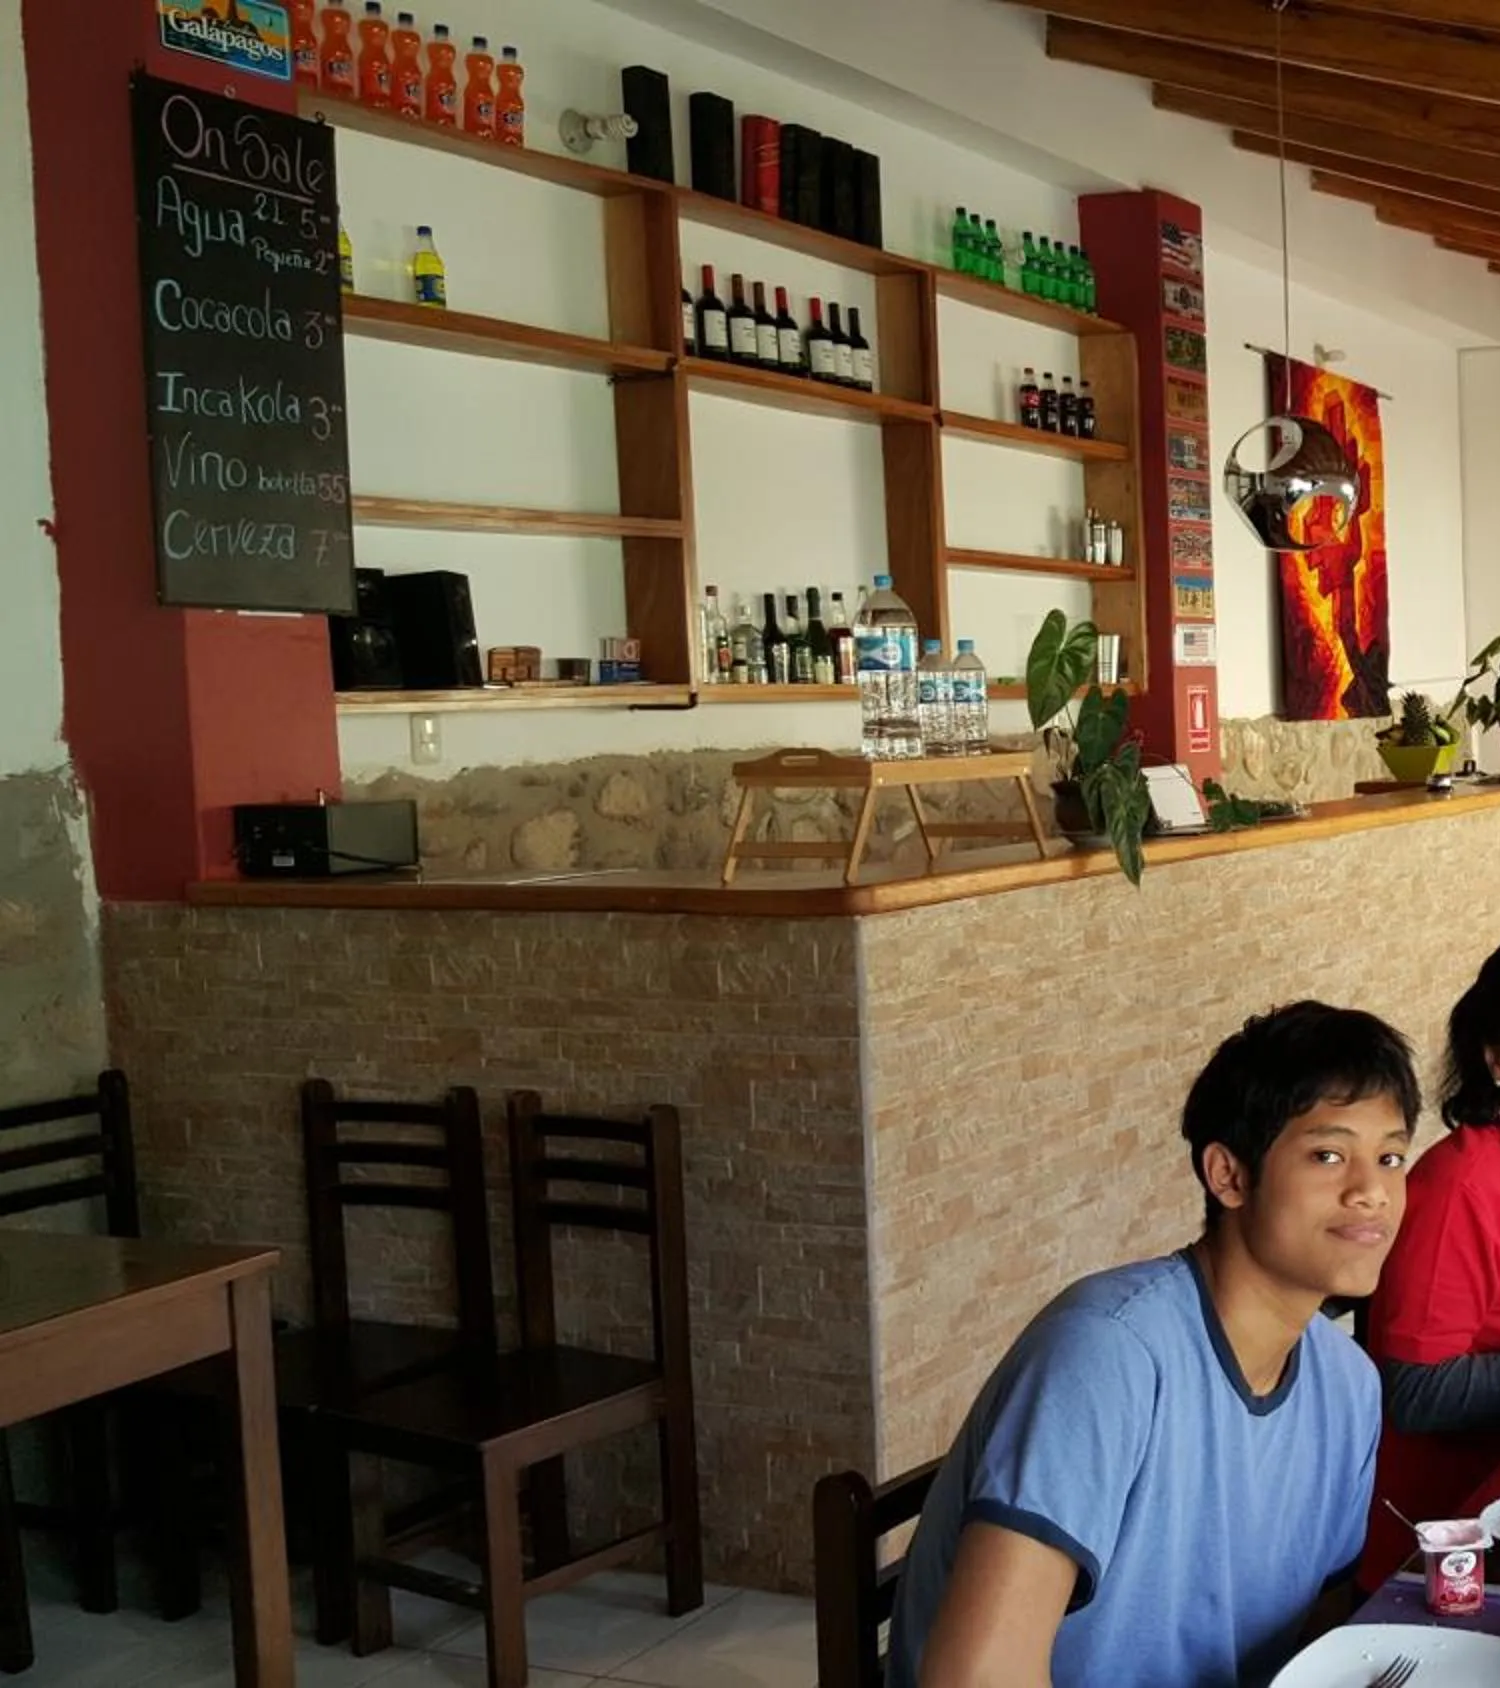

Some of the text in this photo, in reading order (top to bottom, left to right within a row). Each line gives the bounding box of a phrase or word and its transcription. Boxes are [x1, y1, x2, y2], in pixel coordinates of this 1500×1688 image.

[162, 95, 325, 195] On Sale
[157, 175, 246, 257] Agua
[156, 279, 292, 341] Cocacola
[163, 431, 247, 492] Vino
[163, 509, 296, 560] Cerveza
